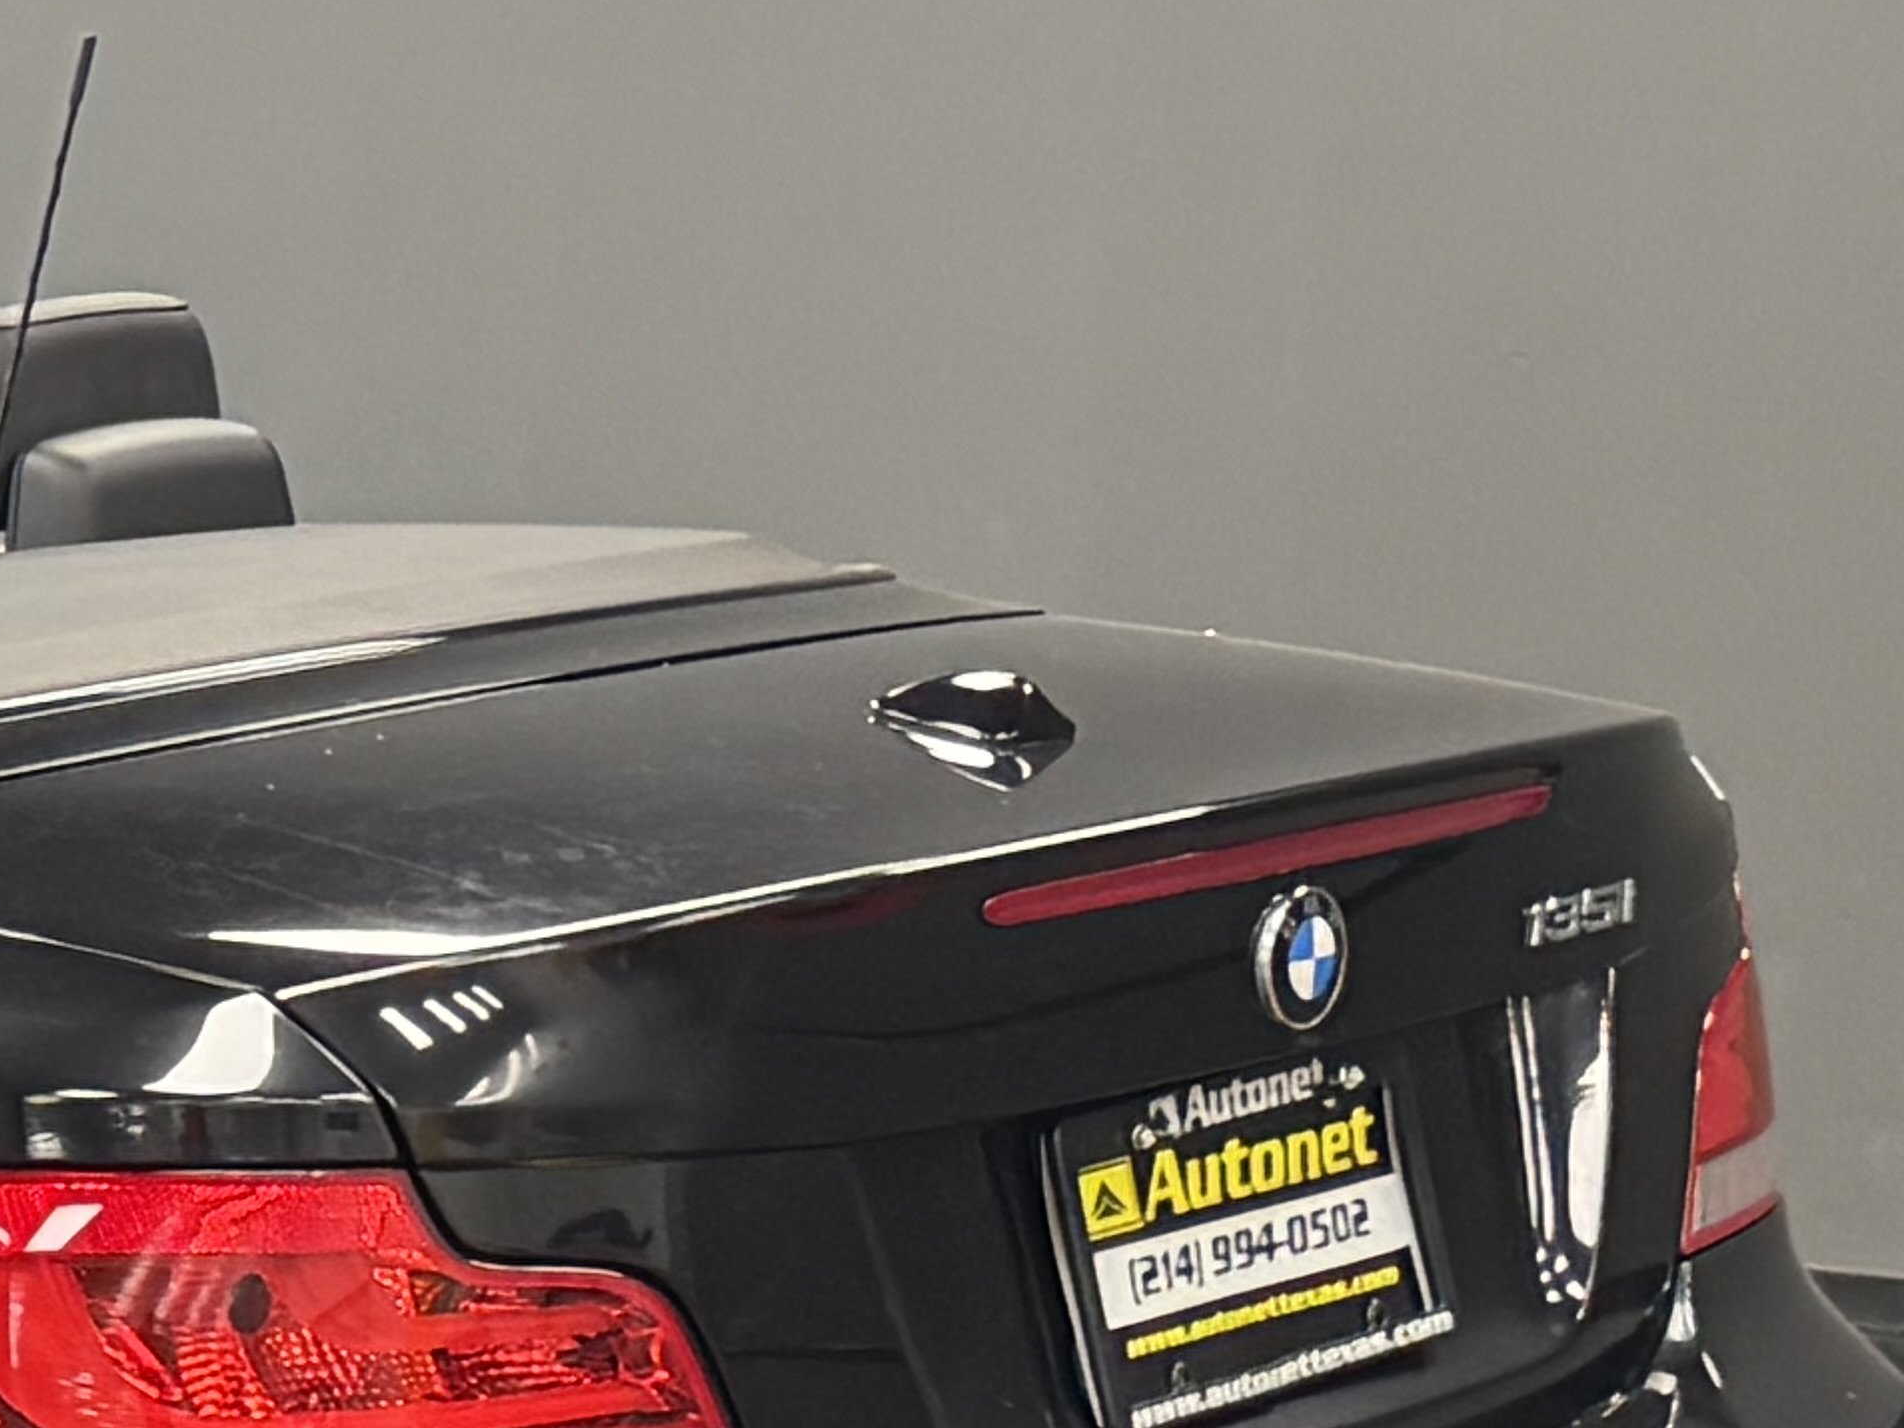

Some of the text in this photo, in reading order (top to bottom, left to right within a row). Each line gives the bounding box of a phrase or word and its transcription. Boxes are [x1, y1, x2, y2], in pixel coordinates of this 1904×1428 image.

[1183, 1057, 1324, 1134] Autonet
[1145, 1106, 1379, 1223] Autonet
[1128, 1198, 1371, 1306] (214) 994-0502
